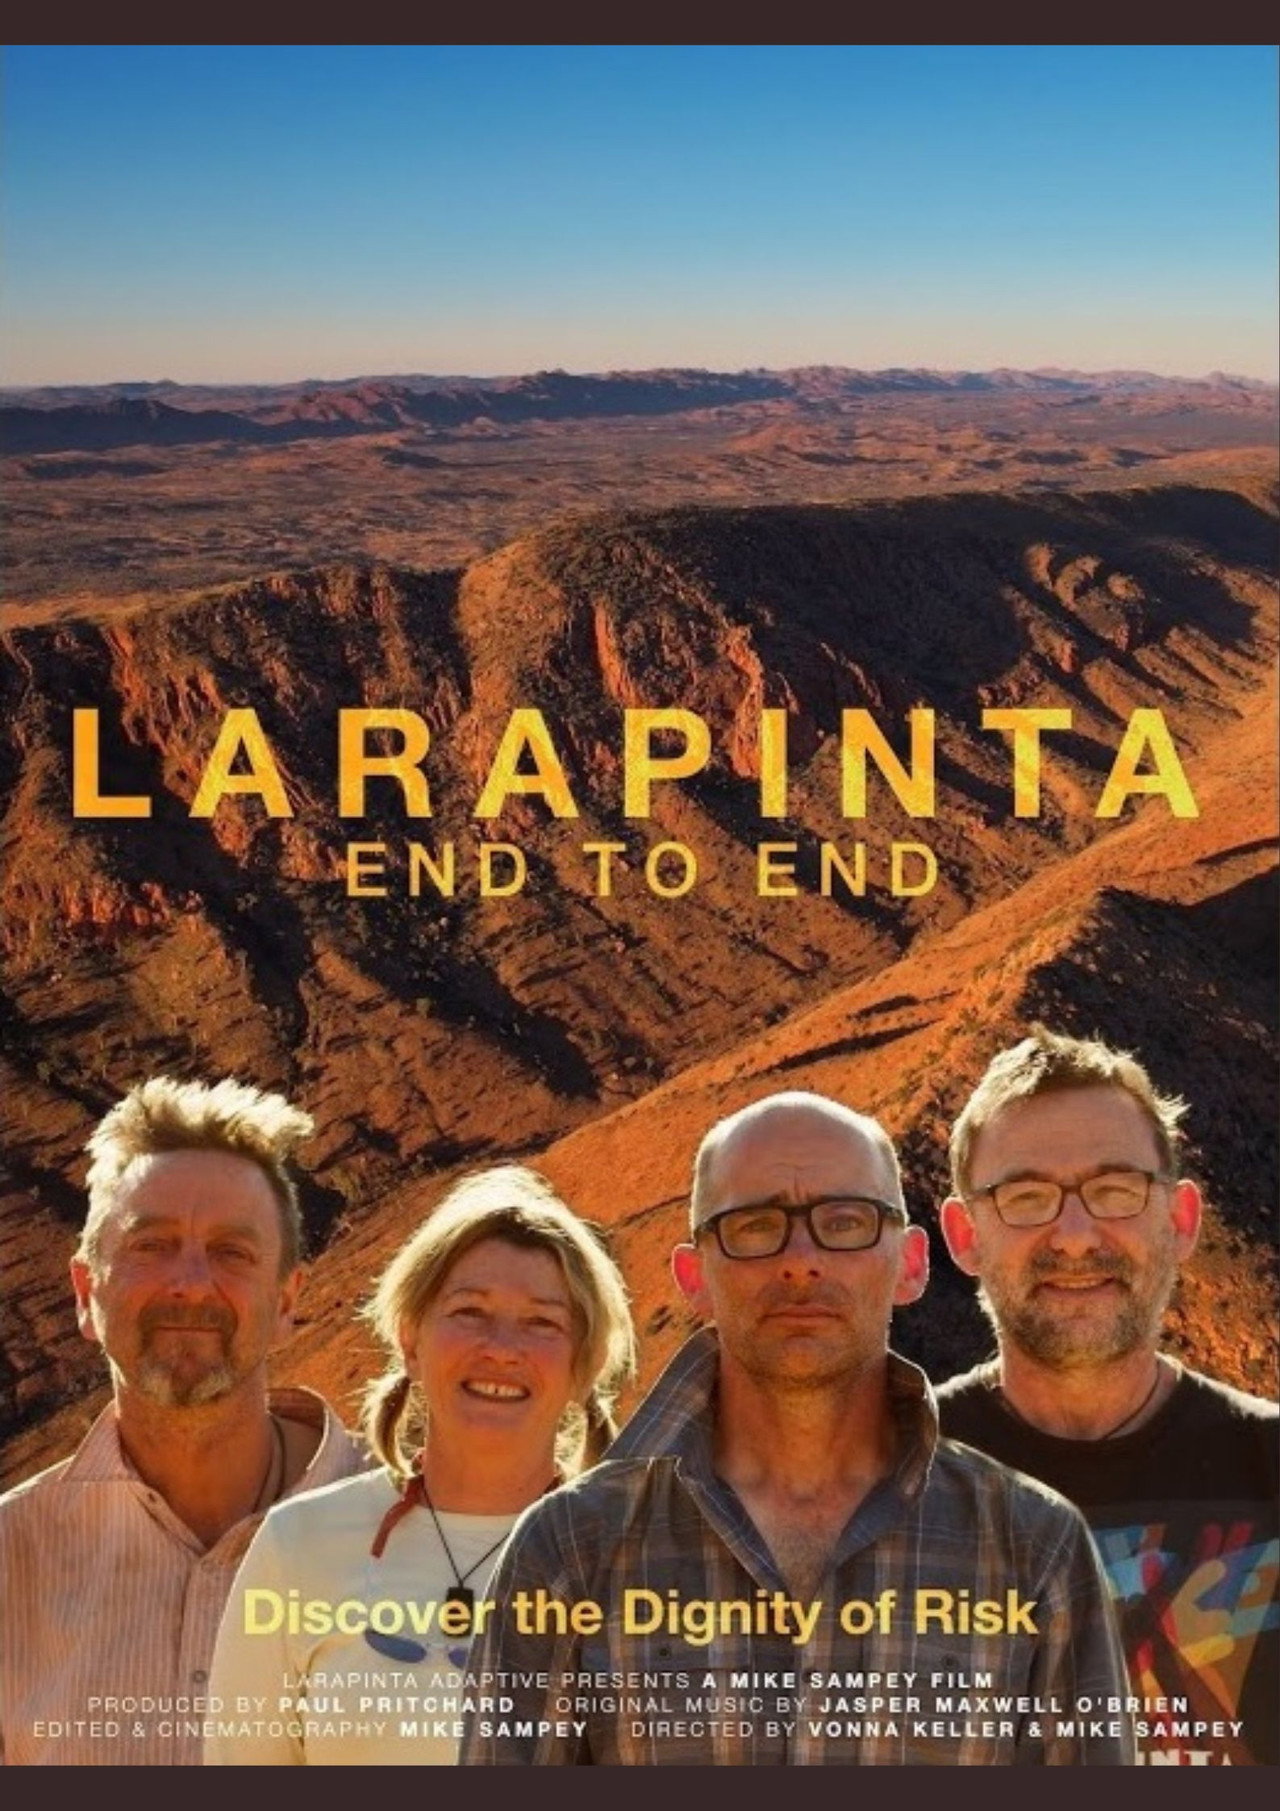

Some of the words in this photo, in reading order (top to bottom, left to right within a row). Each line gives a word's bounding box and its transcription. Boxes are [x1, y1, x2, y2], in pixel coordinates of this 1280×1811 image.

[72, 707, 1200, 819] LARAPINTA
[347, 842, 528, 897] END
[583, 842, 699, 897] TO
[757, 842, 939, 897] END
[243, 1588, 496, 1635] Discover
[512, 1589, 604, 1635] the
[624, 1588, 822, 1646] Dignity
[840, 1588, 897, 1635] of
[915, 1588, 1039, 1635] Risk
[283, 1672, 418, 1689] LARAPINTA
[428, 1672, 549, 1689] ADAPTIVE
[561, 1672, 690, 1689] PRESENTS
[701, 1672, 717, 1689] A
[730, 1672, 796, 1689] MIKE
[810, 1672, 918, 1689] SAMPEY
[931, 1672, 992, 1689] FILM
[88, 1696, 224, 1713] PRODUCED
[237, 1696, 266, 1713] BY
[279, 1696, 346, 1713] PAUL
[359, 1696, 514, 1713] PRITCHARD
[555, 1696, 674, 1713] ORIGINAL
[685, 1696, 764, 1713] MUSIC
[776, 1696, 807, 1713] BY
[819, 1696, 921, 1713] JASPER
[935, 1696, 1063, 1713] MAXWELL
[1077, 1696, 1188, 1713] O'BRIEN
[33, 1721, 121, 1738] EDITED
[131, 1721, 146, 1738] &
[157, 1721, 387, 1738] CINEMATOGRAPHY
[400, 1721, 466, 1738] MIKE
[479, 1721, 588, 1738] SAMPEY
[631, 1721, 754, 1738] DIRECTED
[765, 1721, 797, 1738] BY
[808, 1721, 900, 1738] VONNA
[912, 1721, 1015, 1738] KELLER
[1028, 1721, 1042, 1738] &
[1056, 1721, 1122, 1738] MIKE
[1135, 1721, 1244, 1738] SAMPEY
